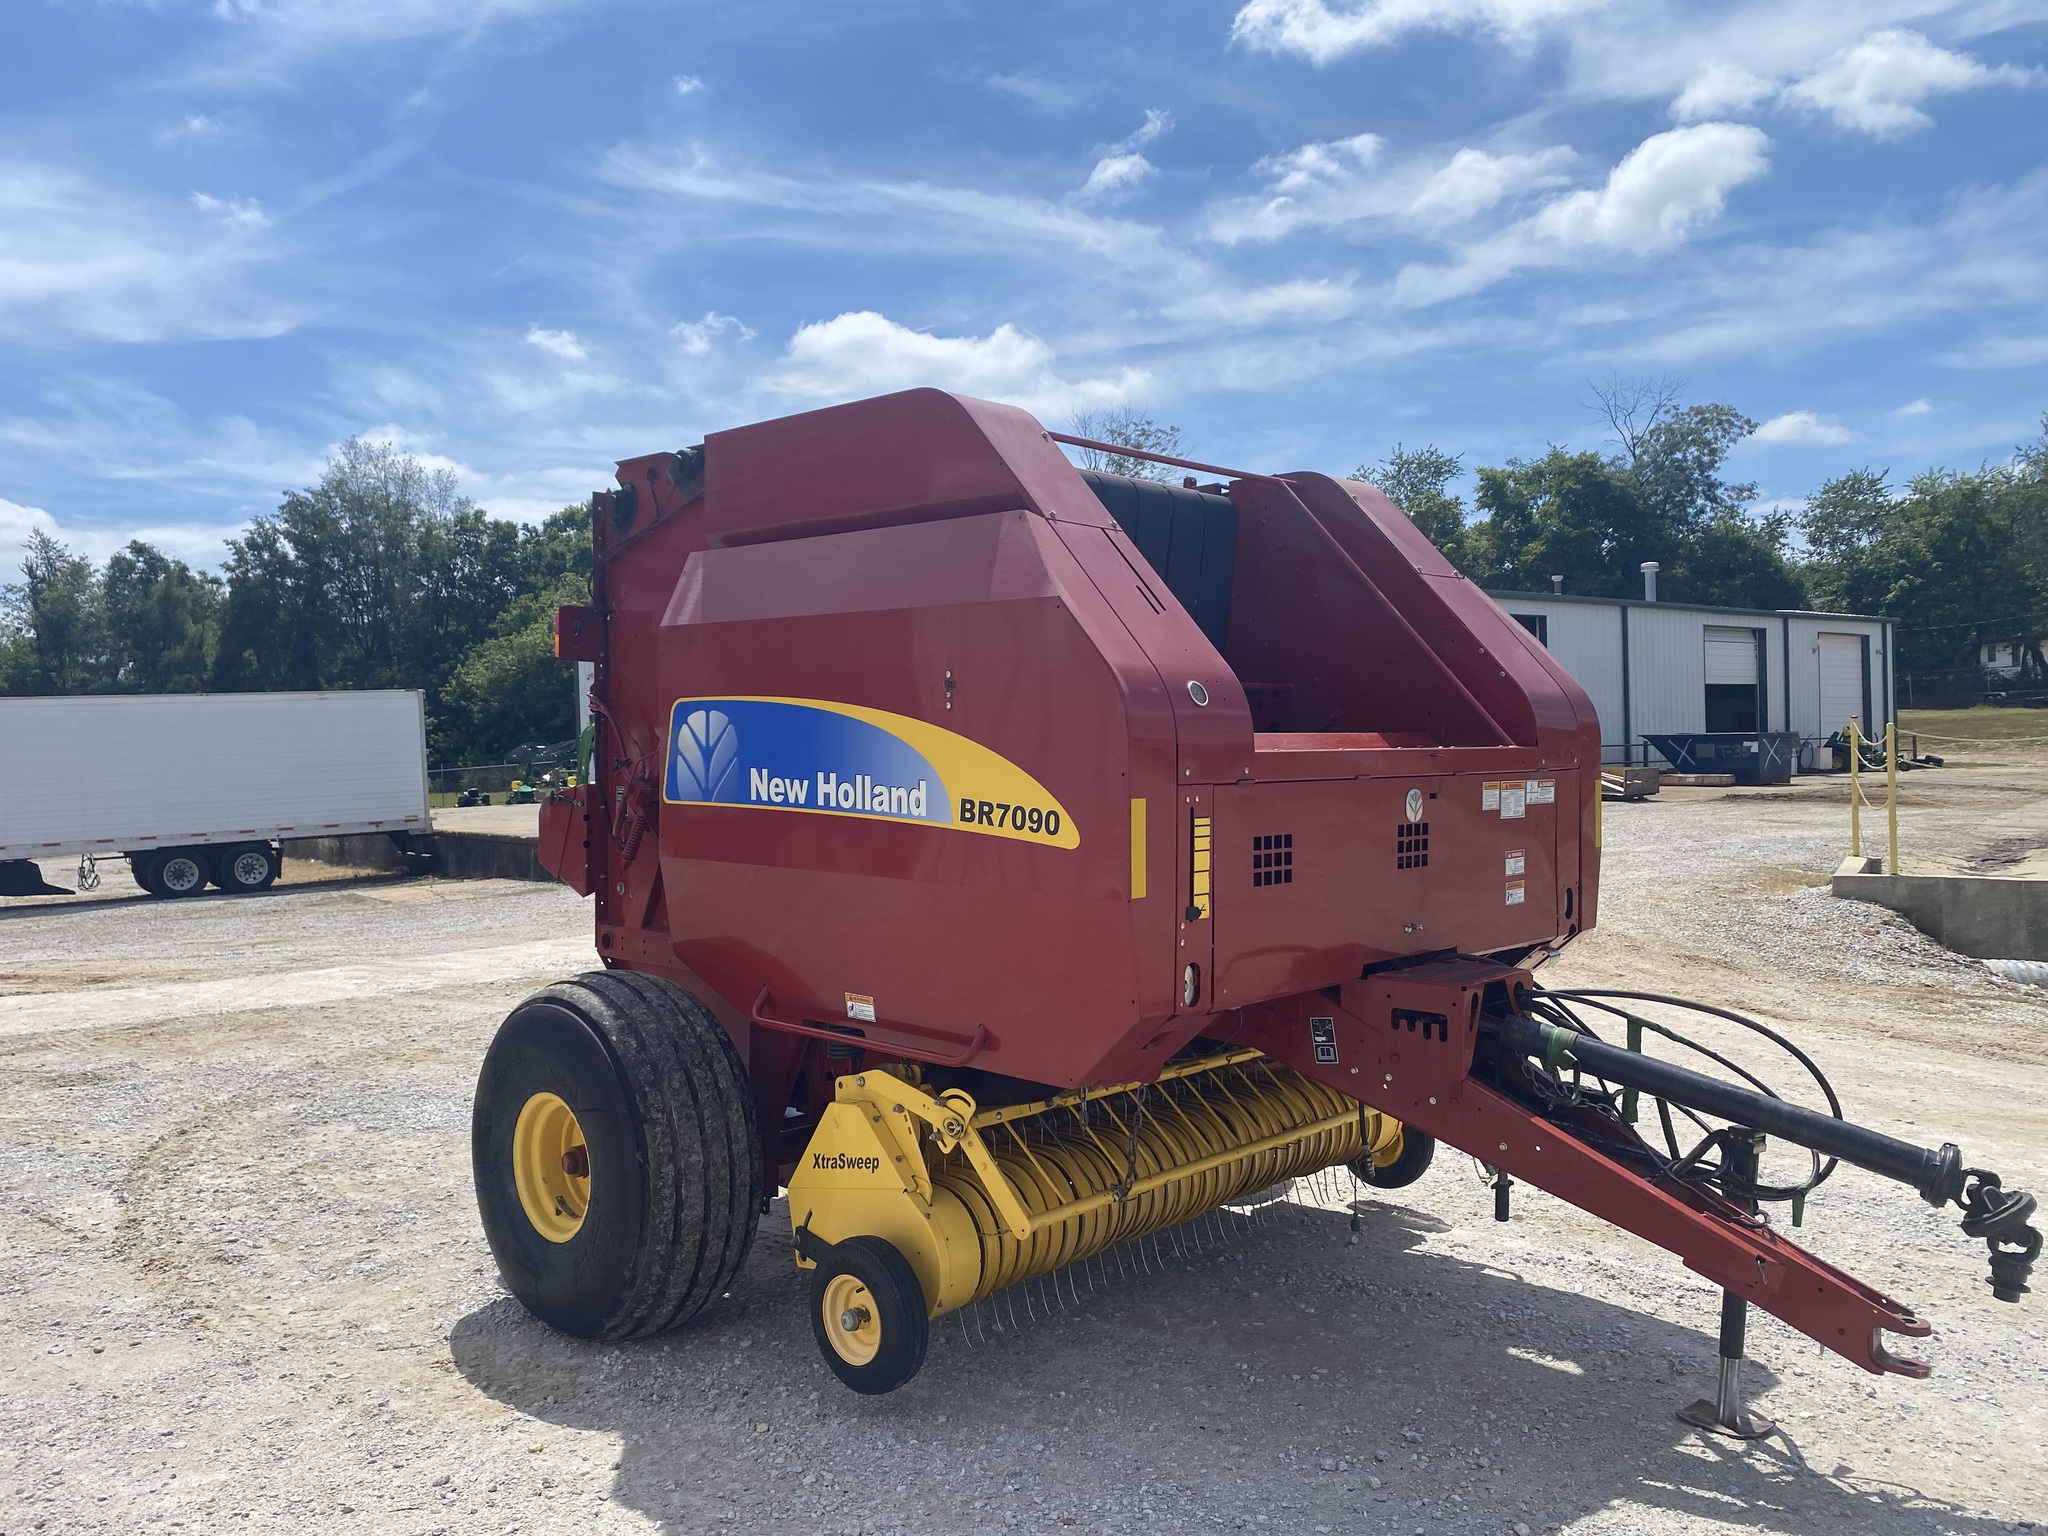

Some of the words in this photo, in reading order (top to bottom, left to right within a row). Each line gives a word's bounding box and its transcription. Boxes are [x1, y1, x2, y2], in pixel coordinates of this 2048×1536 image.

[750, 767, 809, 805] New
[817, 771, 927, 817] Holland
[959, 797, 1060, 836] BR7090
[813, 1152, 880, 1174] XtraSweep
